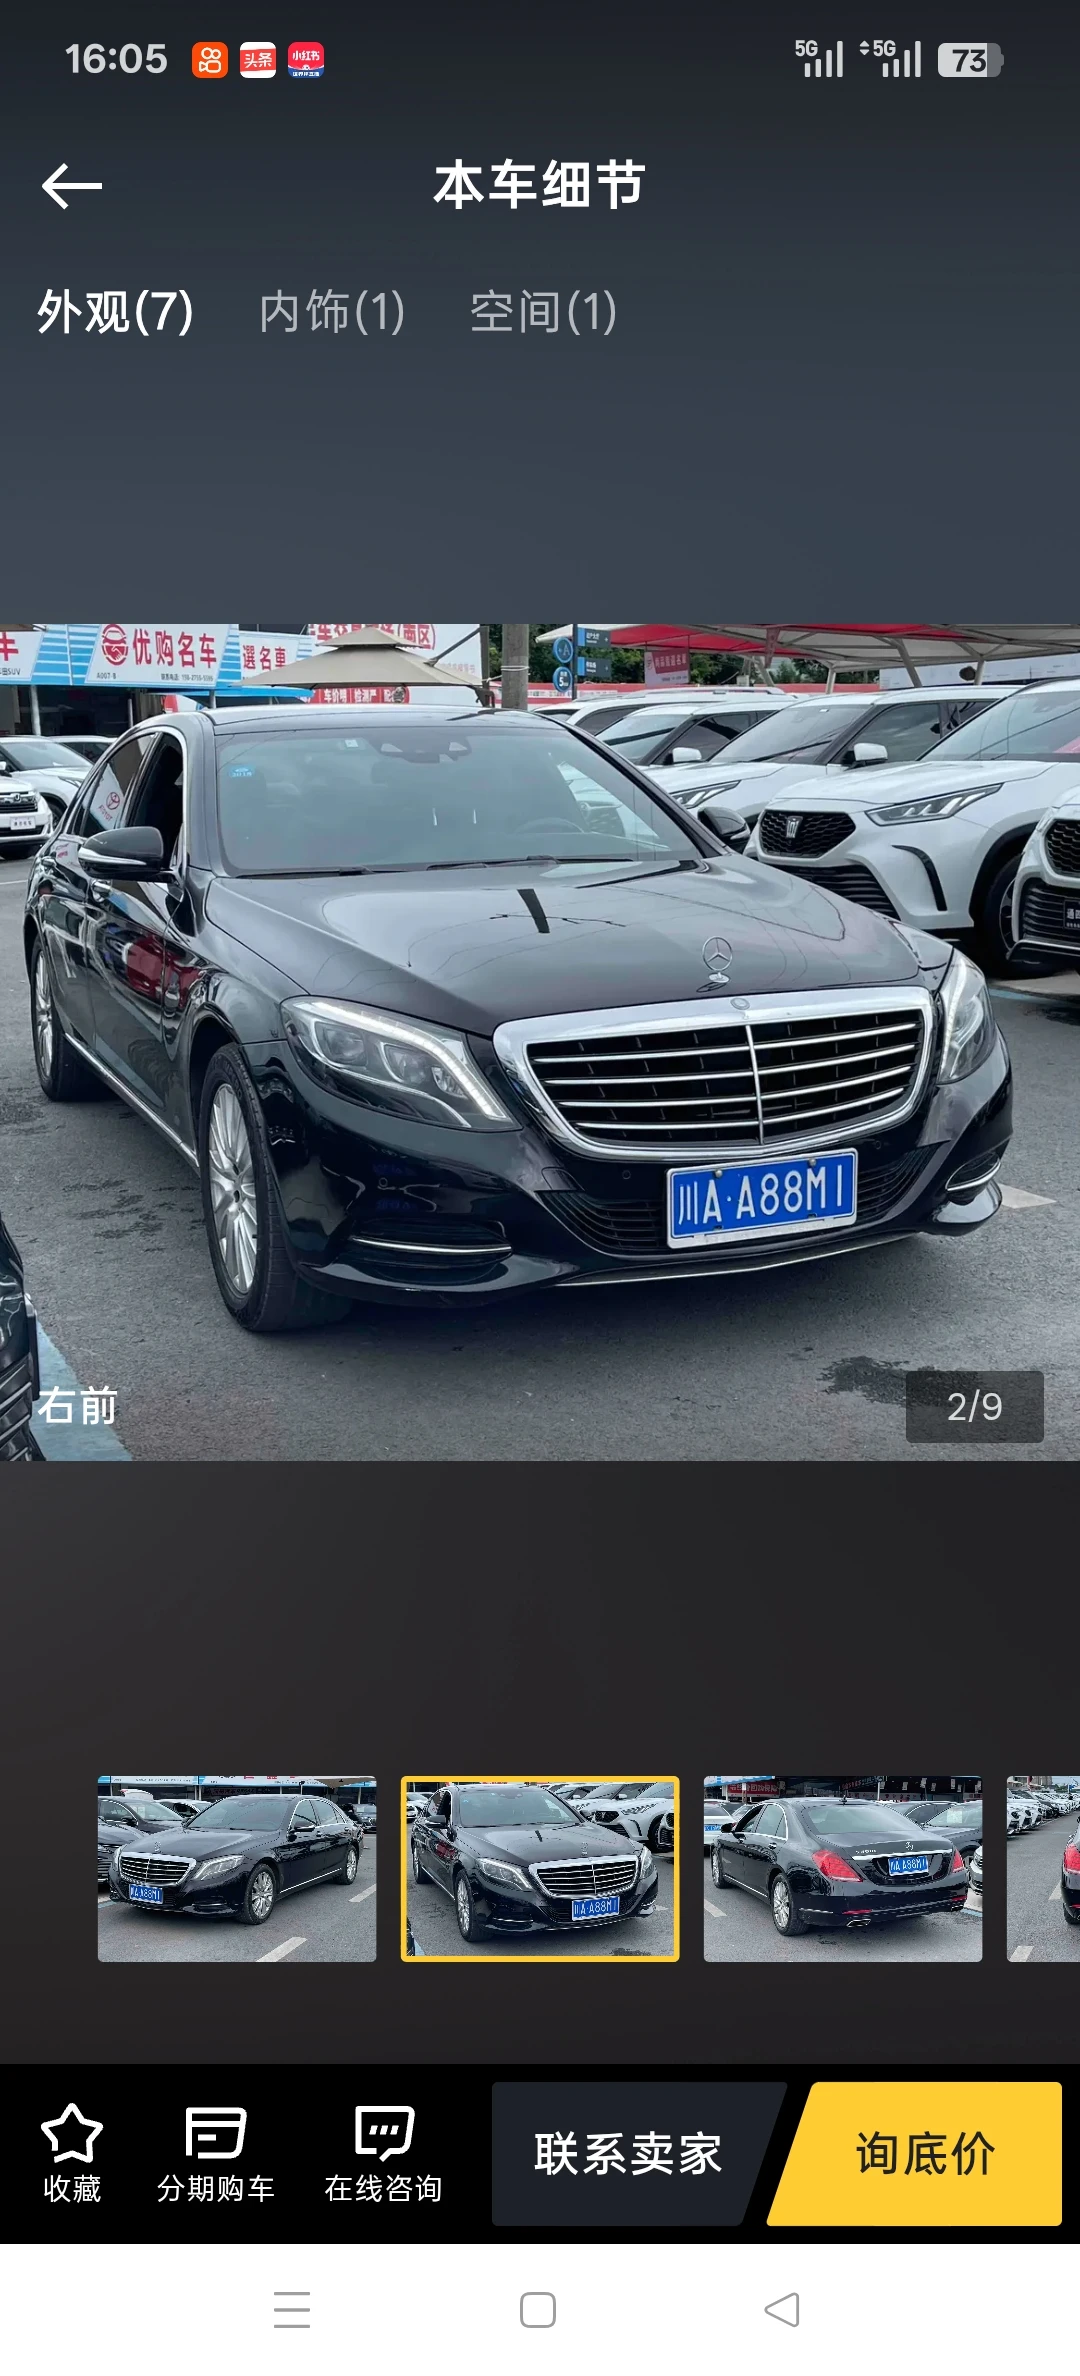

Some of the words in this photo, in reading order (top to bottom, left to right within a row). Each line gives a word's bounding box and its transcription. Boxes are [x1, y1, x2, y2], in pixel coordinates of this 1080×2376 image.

[65, 43, 167, 74] 16:05
[244, 52, 272, 68] 头条
[292, 50, 320, 61] 小红书
[795, 39, 818, 57] 5G
[873, 39, 896, 57] 5G
[952, 49, 986, 72] 73
[433, 158, 645, 210] 本车细节
[37, 289, 193, 336] 外观(7)
[261, 289, 404, 336] 内饰(1)
[470, 289, 616, 336] 空间(1)
[132, 628, 217, 669] 优购名车
[559, 676, 564, 687] 5
[534, 2131, 722, 2176] 联系卖家
[856, 2131, 995, 2176] 询底价
[43, 2174, 102, 2204] 收藏
[157, 2174, 275, 2203] 分期购车
[325, 2174, 442, 2203] 在线咨询
